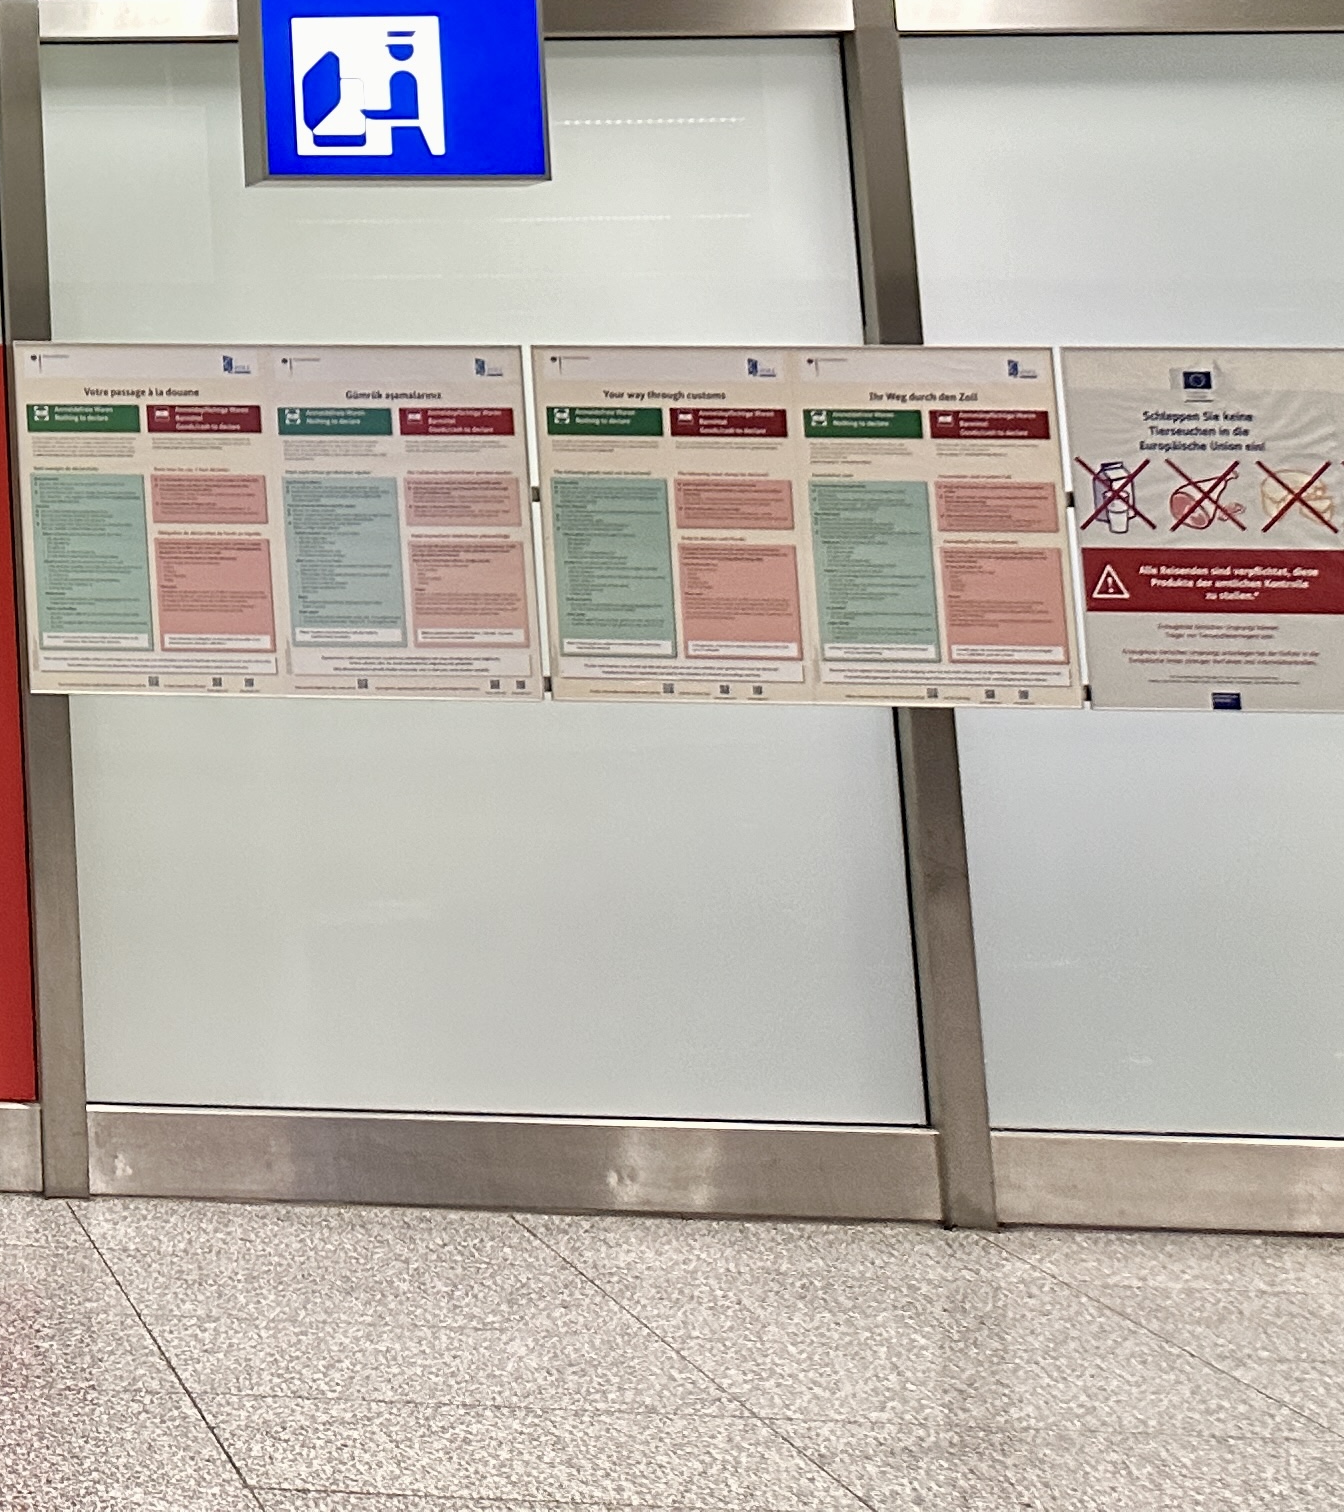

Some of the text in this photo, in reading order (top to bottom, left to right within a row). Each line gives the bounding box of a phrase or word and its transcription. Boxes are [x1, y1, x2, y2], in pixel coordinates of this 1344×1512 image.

[110, 389, 146, 399] passage
[166, 388, 199, 397] douane
[603, 390, 726, 401] Your way through customs
[886, 392, 907, 403] Weg
[909, 393, 937, 402] durch
[938, 393, 957, 402] den
[959, 393, 978, 402] Zoll
[1143, 410, 1254, 424] Schleppen Sie keine
[1149, 425, 1250, 437] Tierseuchen in die
[1139, 440, 1207, 453] Europäische
[1209, 440, 1243, 452] Union
